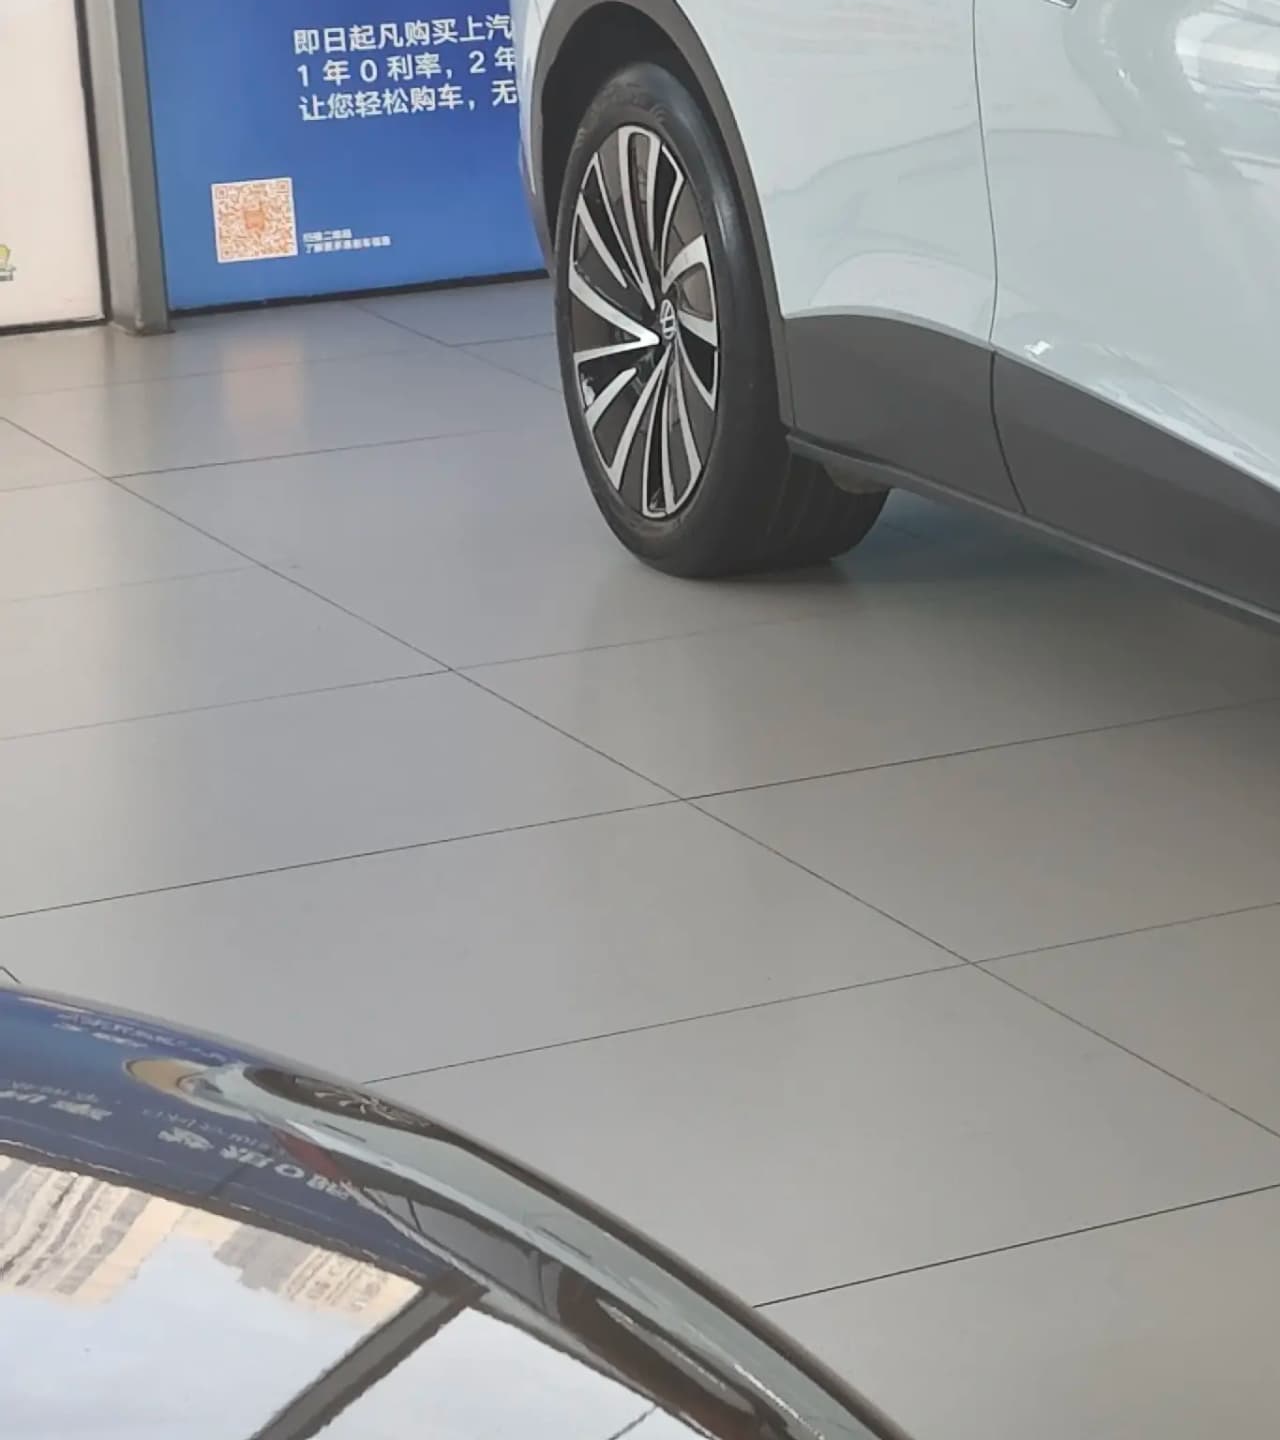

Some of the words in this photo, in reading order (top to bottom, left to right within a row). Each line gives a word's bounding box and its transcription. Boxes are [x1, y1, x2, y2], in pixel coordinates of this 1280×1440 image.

[293, 13, 513, 56] 即日起凡购买上汽
